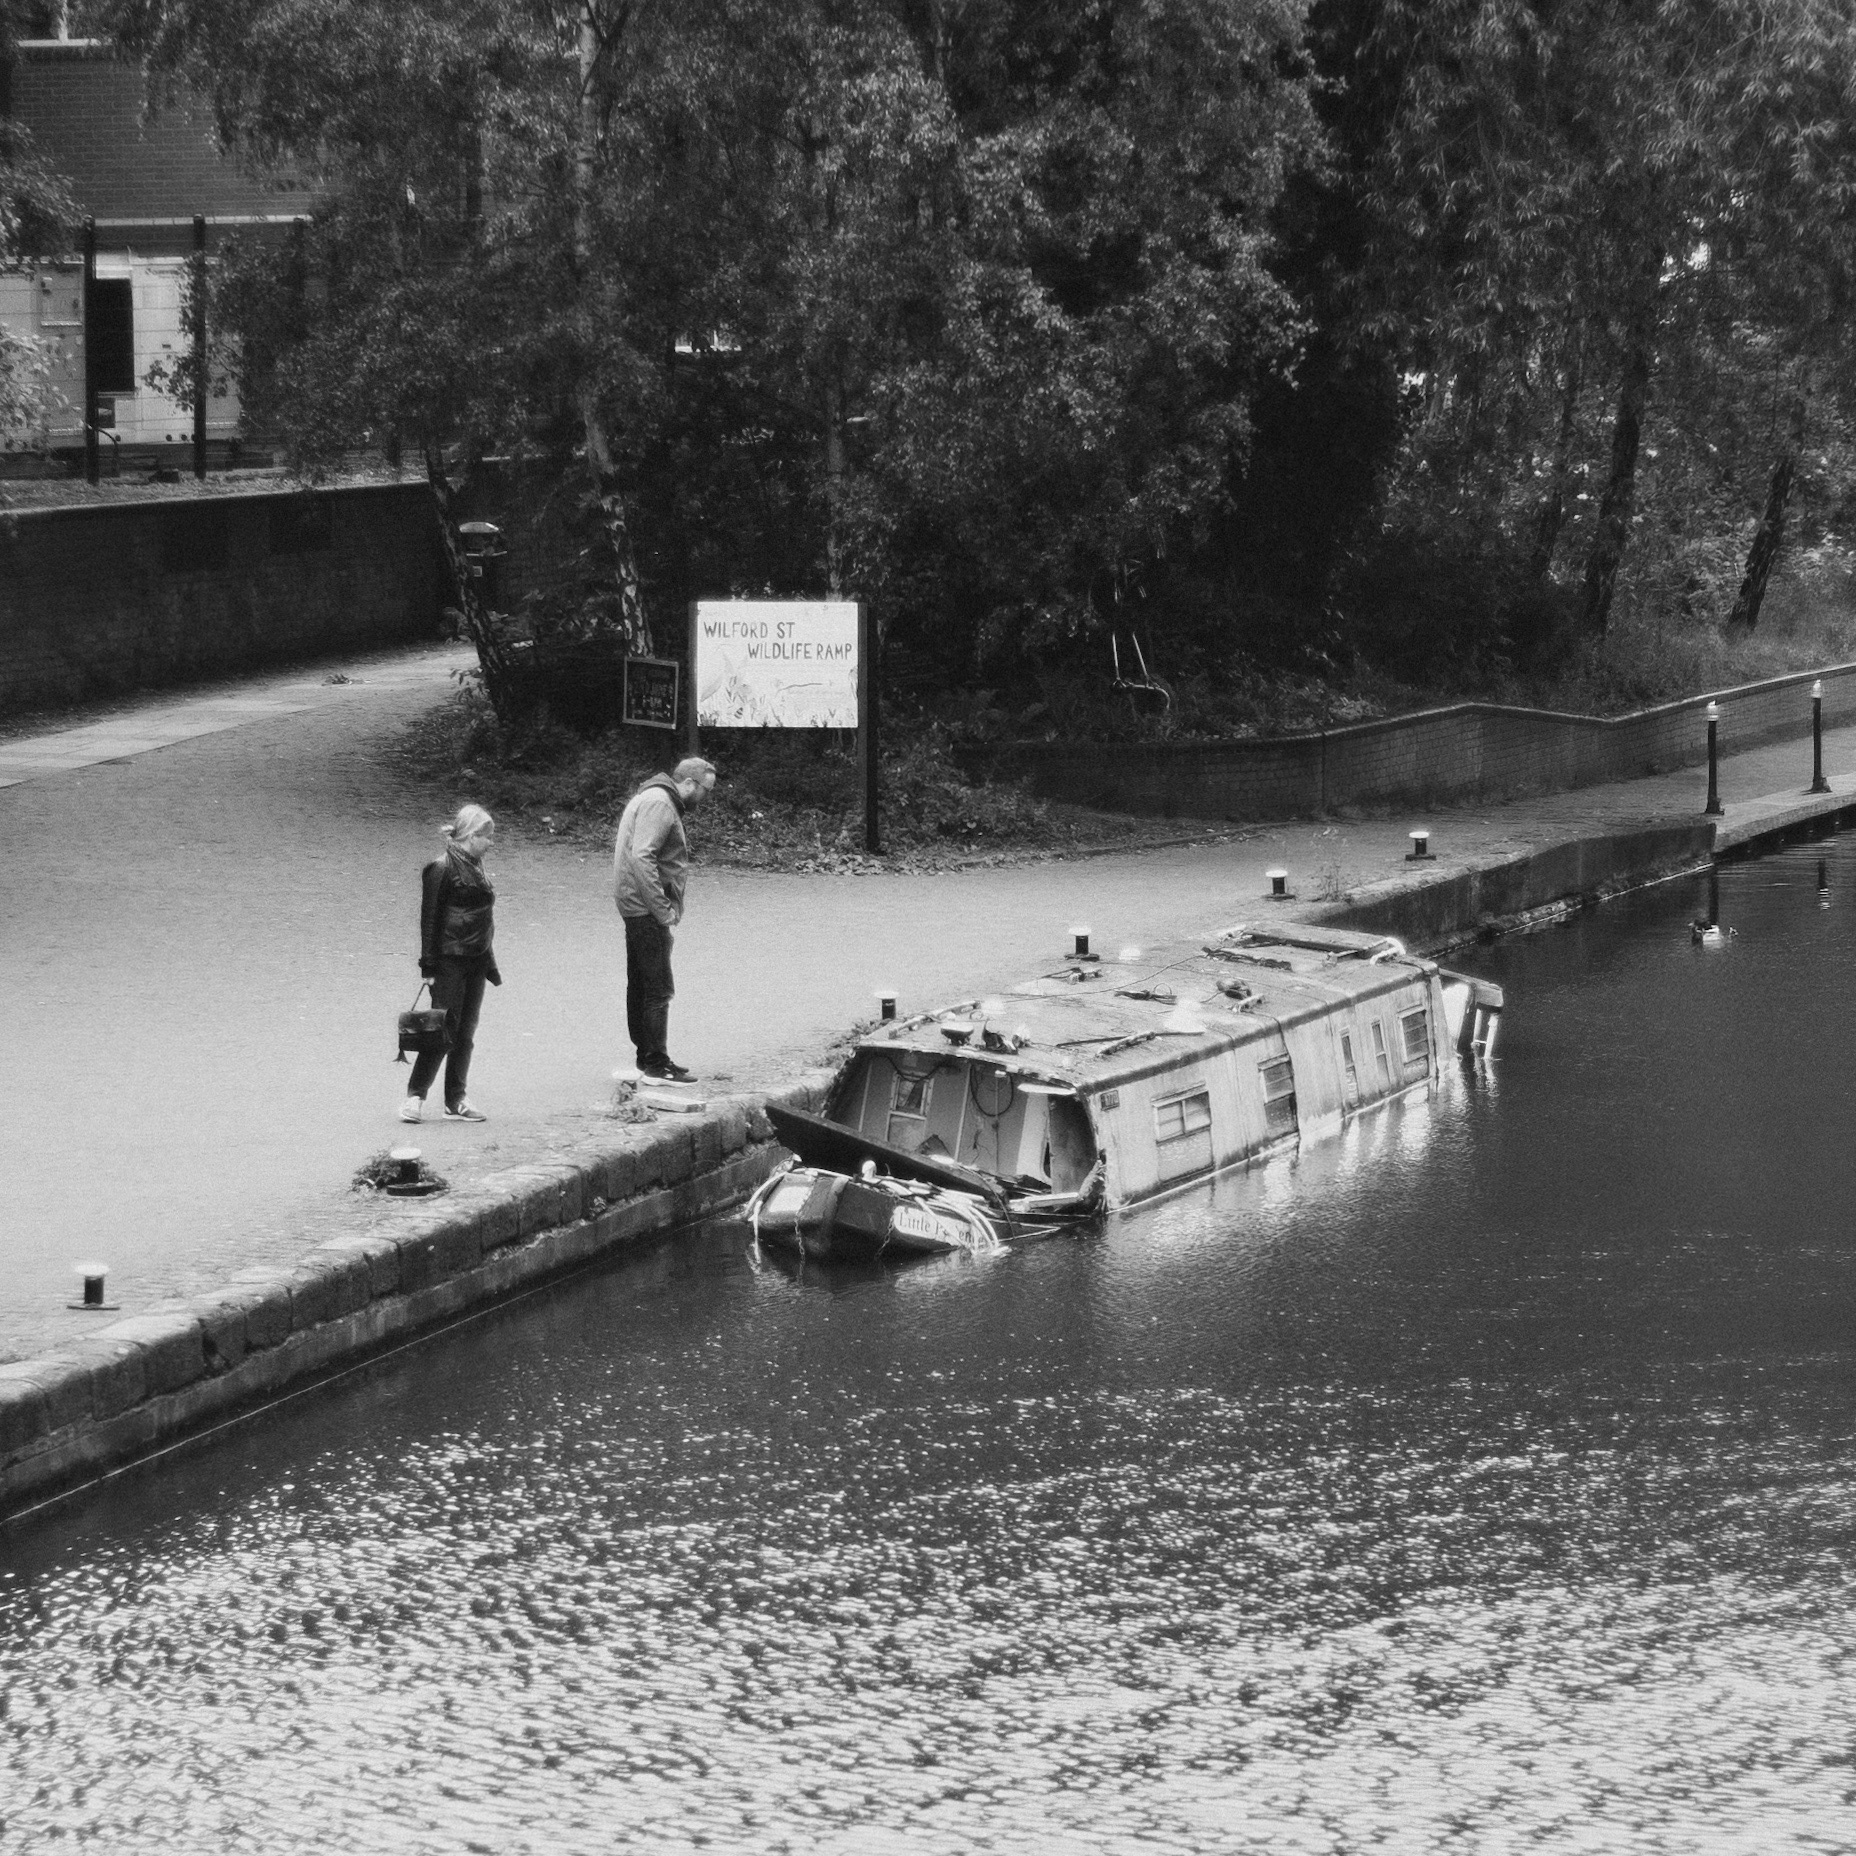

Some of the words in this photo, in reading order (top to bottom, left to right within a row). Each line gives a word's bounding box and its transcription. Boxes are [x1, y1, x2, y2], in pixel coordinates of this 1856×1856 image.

[703, 621, 768, 638] WILFORD
[776, 621, 796, 639] ST
[748, 642, 813, 660] WILDLIFE
[816, 643, 852, 660] RAMP
[900, 1212, 930, 1232] Little
